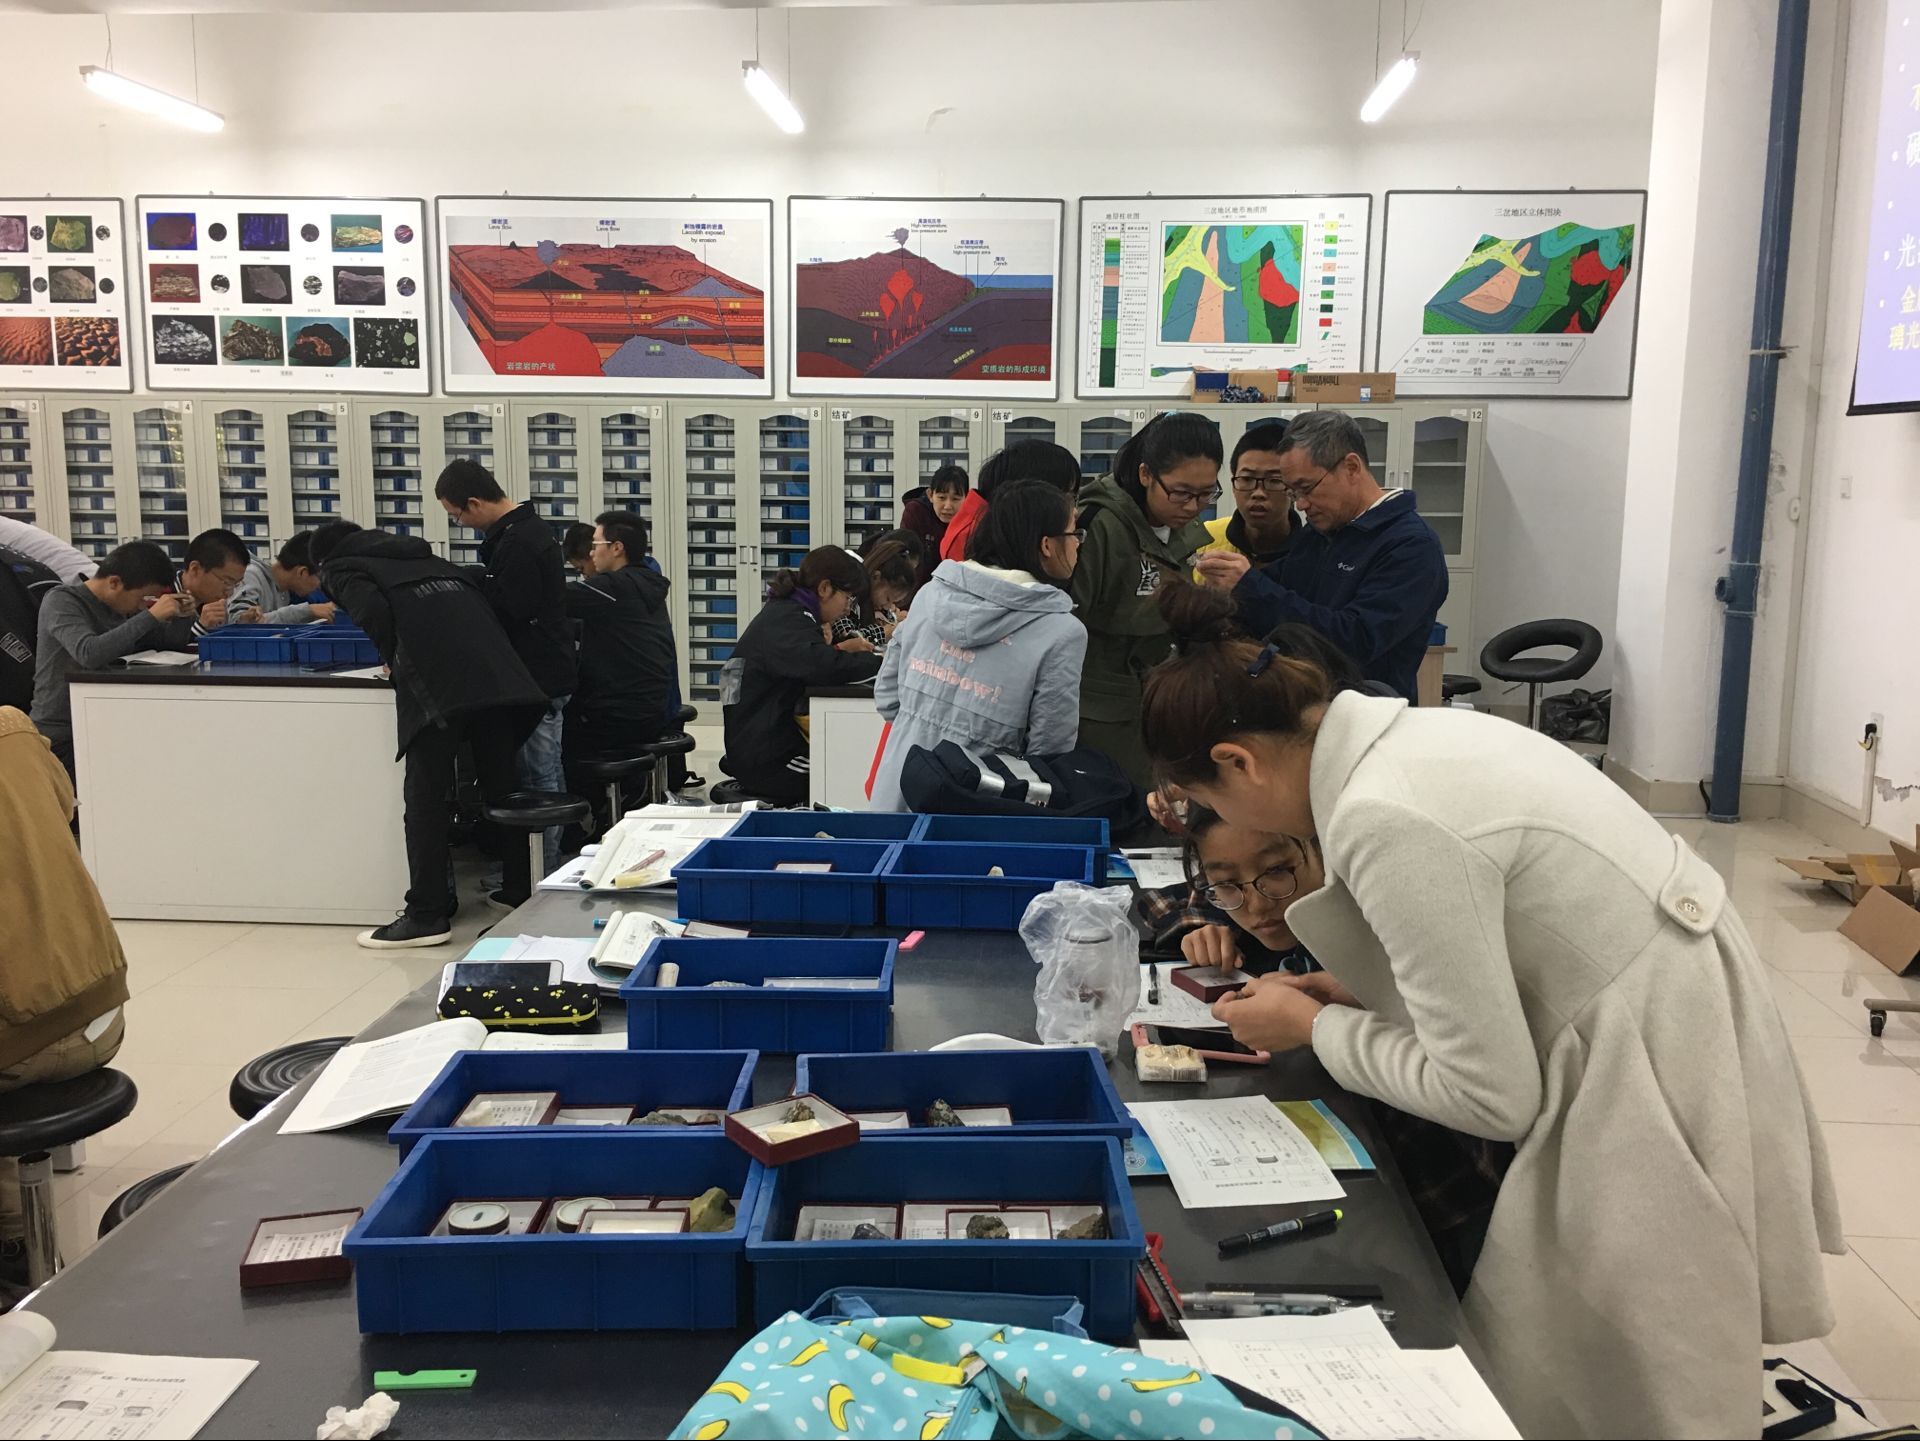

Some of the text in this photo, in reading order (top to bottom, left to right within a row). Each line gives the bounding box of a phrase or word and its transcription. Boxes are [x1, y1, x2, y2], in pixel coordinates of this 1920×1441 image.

[1494, 208, 1561, 217] 三岔地区立体图块
[507, 362, 556, 371] 岩浆岩的产状
[982, 365, 1046, 374] 变质岩的形成环境
[832, 410, 850, 420] 结矿
[992, 411, 1011, 420] 结矿
